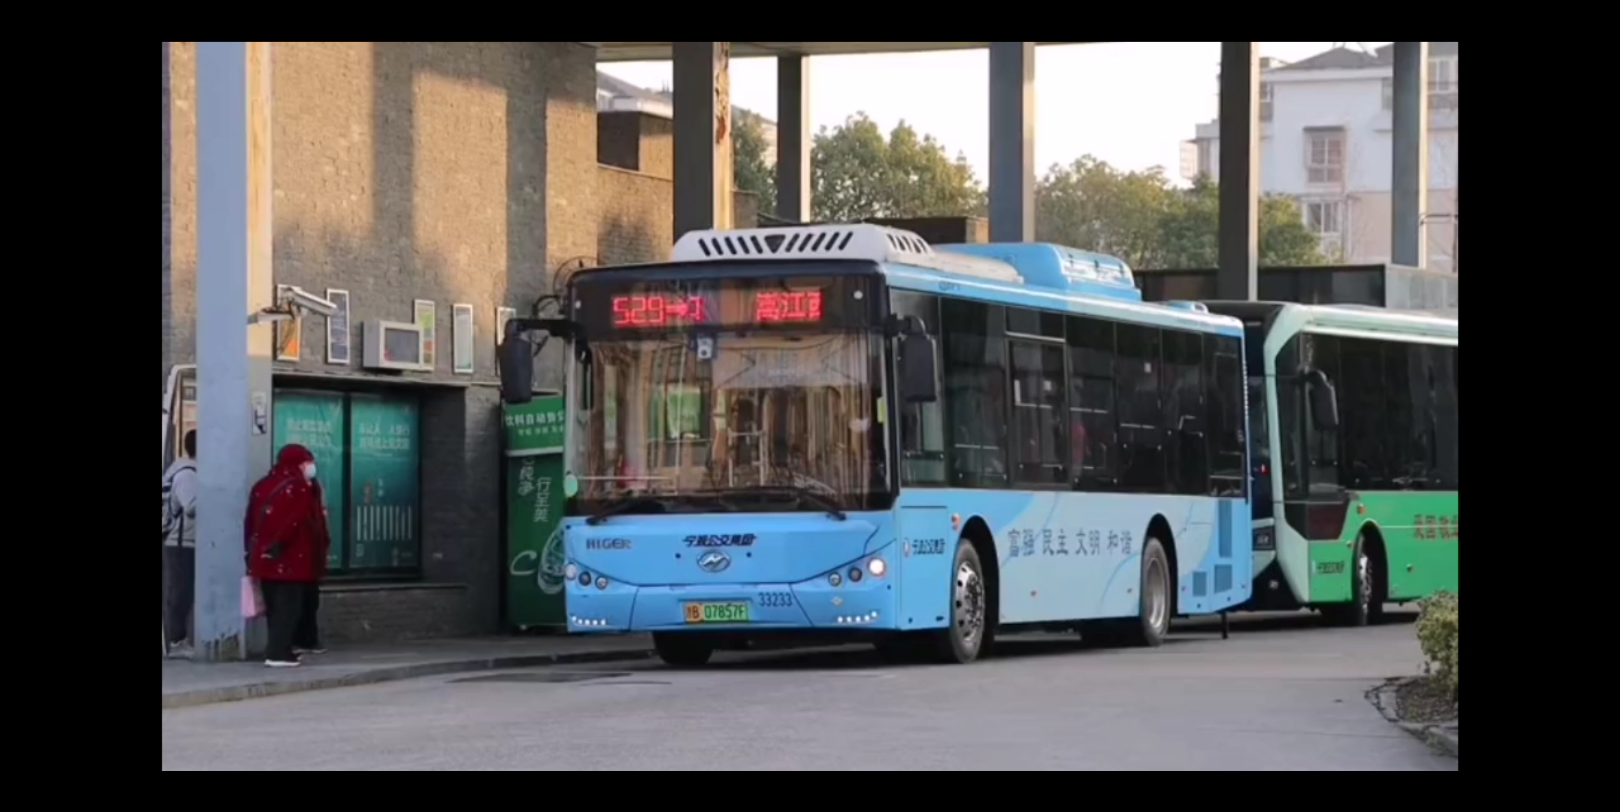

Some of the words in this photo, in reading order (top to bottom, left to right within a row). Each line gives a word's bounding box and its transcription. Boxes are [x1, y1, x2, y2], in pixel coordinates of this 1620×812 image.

[612, 294, 664, 326] 529
[586, 537, 633, 550] HIGER
[1007, 528, 1035, 557] 富强
[1042, 528, 1069, 556] 民主
[1075, 528, 1101, 556] 文明
[1107, 529, 1133, 555] 和谐
[757, 592, 792, 607] 33233
